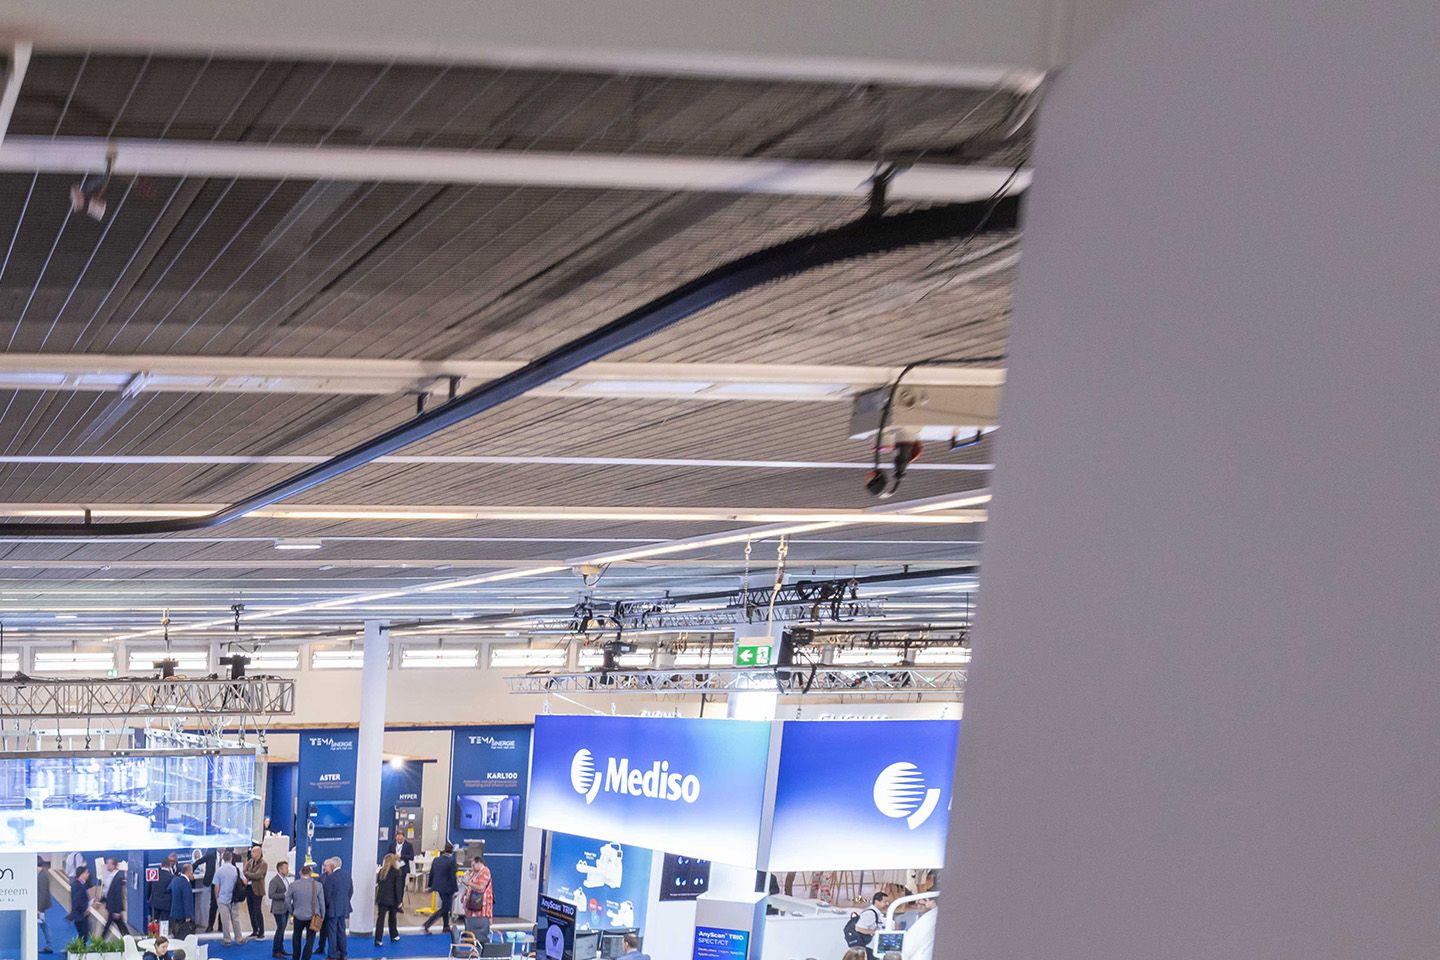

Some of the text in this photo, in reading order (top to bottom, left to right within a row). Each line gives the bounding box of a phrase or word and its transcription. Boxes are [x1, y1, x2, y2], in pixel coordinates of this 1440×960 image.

[320, 773, 341, 781] ASTER
[604, 756, 701, 804] Mediso
[729, 933, 744, 941] TRIO
